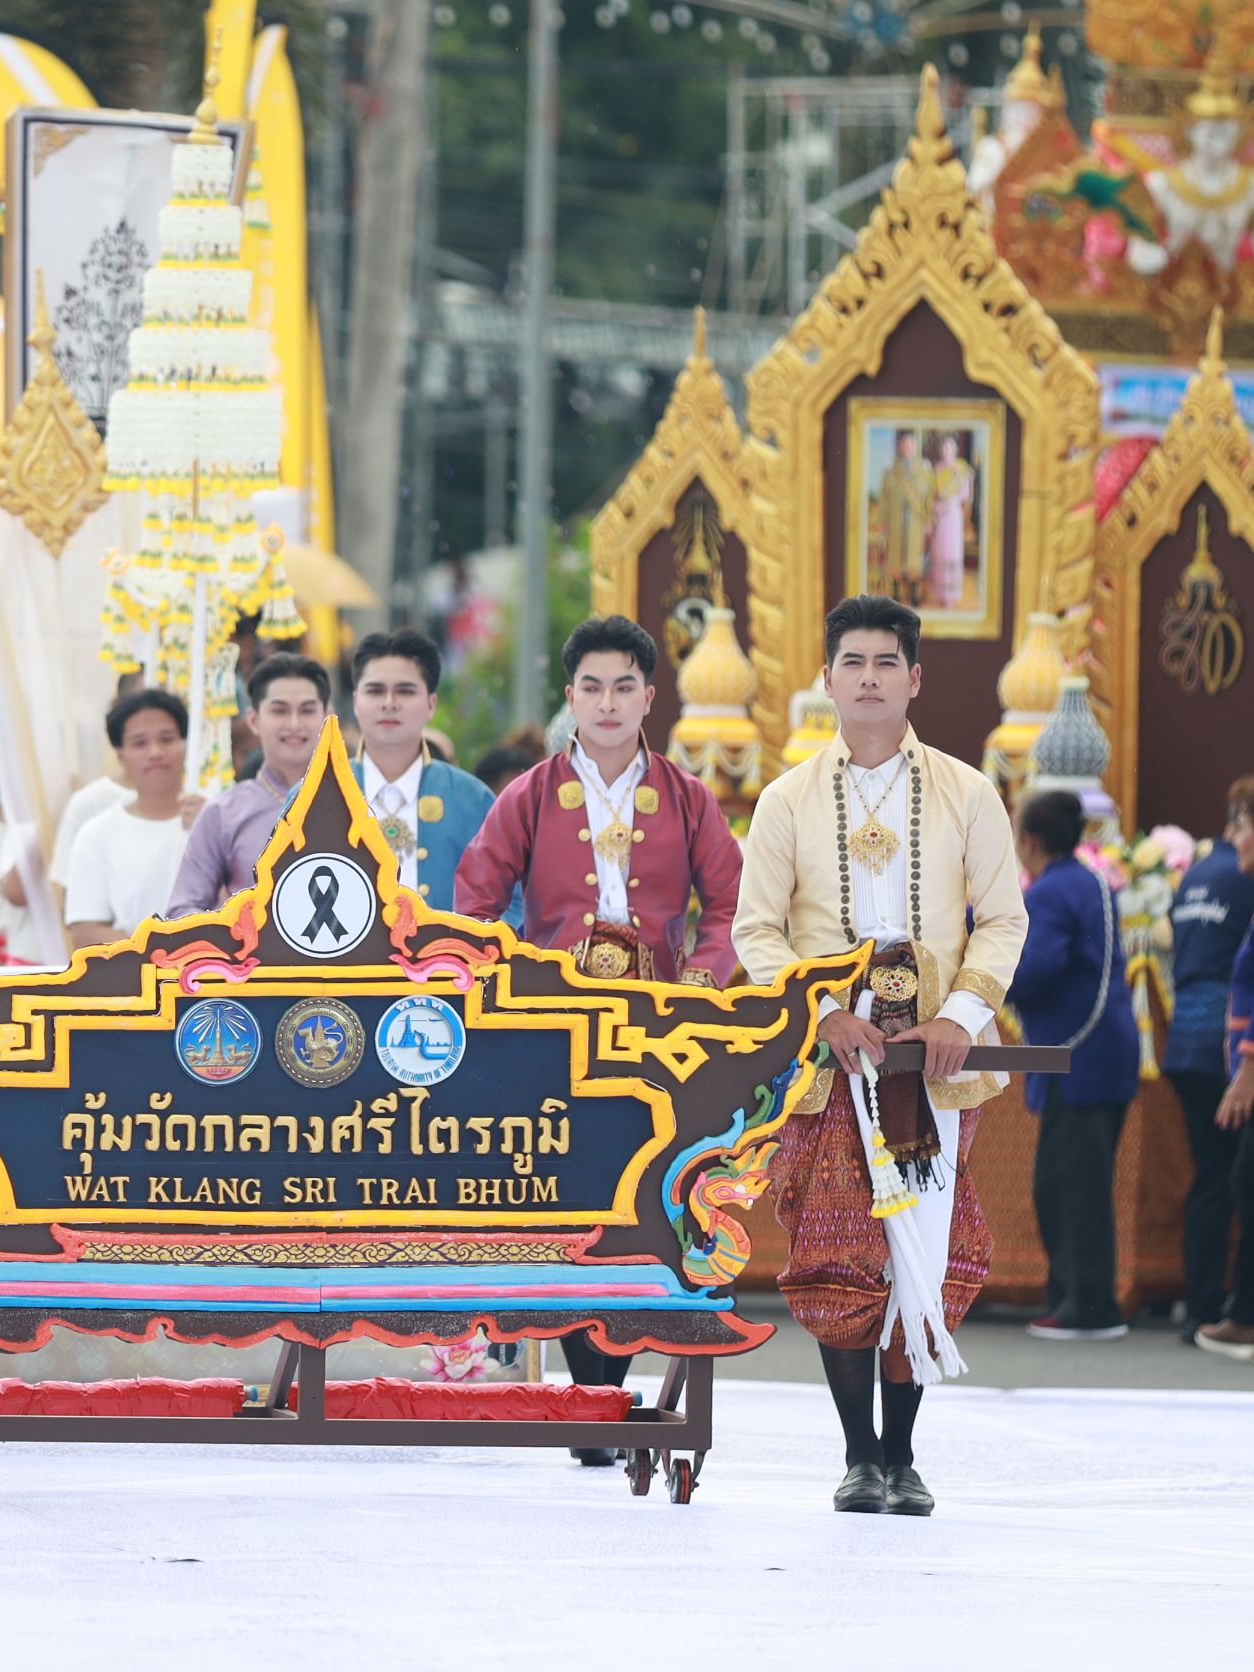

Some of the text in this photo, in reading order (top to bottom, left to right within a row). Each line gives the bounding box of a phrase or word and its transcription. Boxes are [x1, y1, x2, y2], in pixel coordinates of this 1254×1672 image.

[380, 1048, 400, 1073] TOURISM
[399, 1069, 434, 1083] AUTHORITY
[62, 1087, 571, 1175] คุ้มวัดกลางศรีไตรภูมิ
[64, 1175, 559, 1205] WAT KLANG SRI TRAI BHUM
